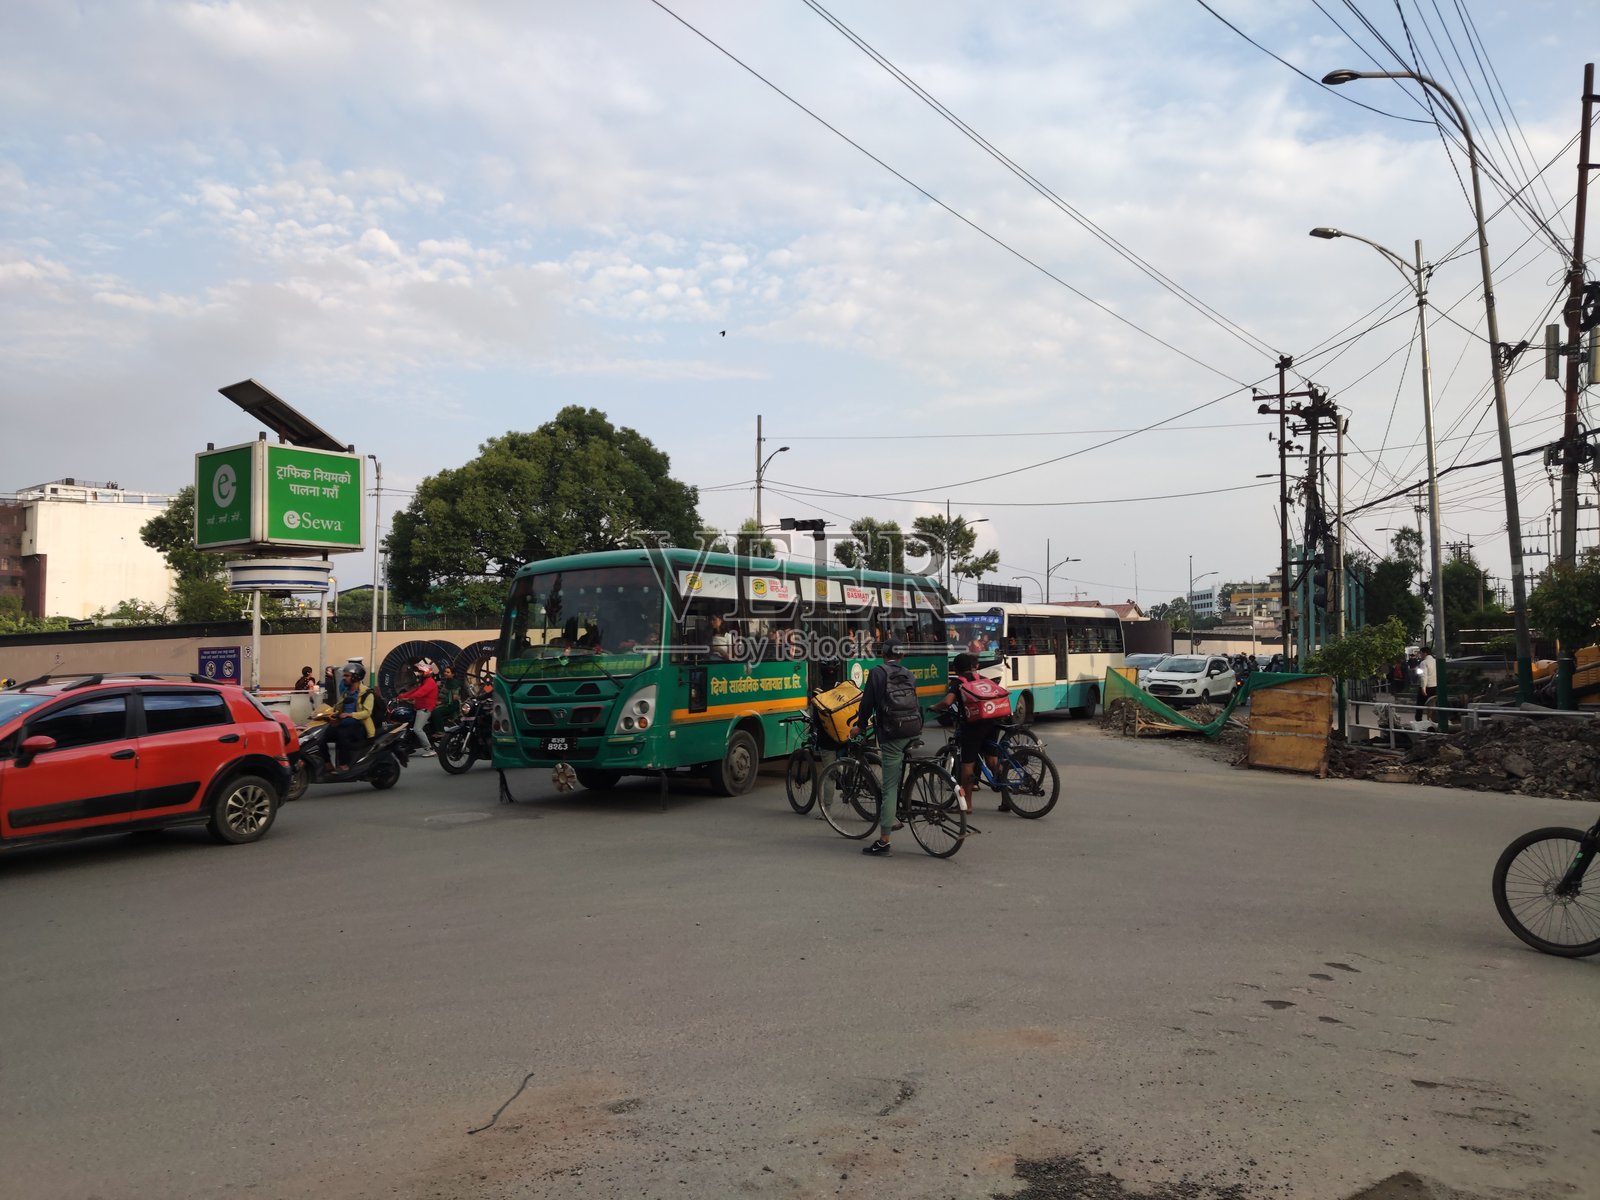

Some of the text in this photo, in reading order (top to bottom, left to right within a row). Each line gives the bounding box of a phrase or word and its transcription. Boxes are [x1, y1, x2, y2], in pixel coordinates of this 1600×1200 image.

[276, 464, 351, 484] ट्राफिक नियमको
[289, 483, 320, 496] पालना
[729, 676, 760, 693] सार्वजनिक
